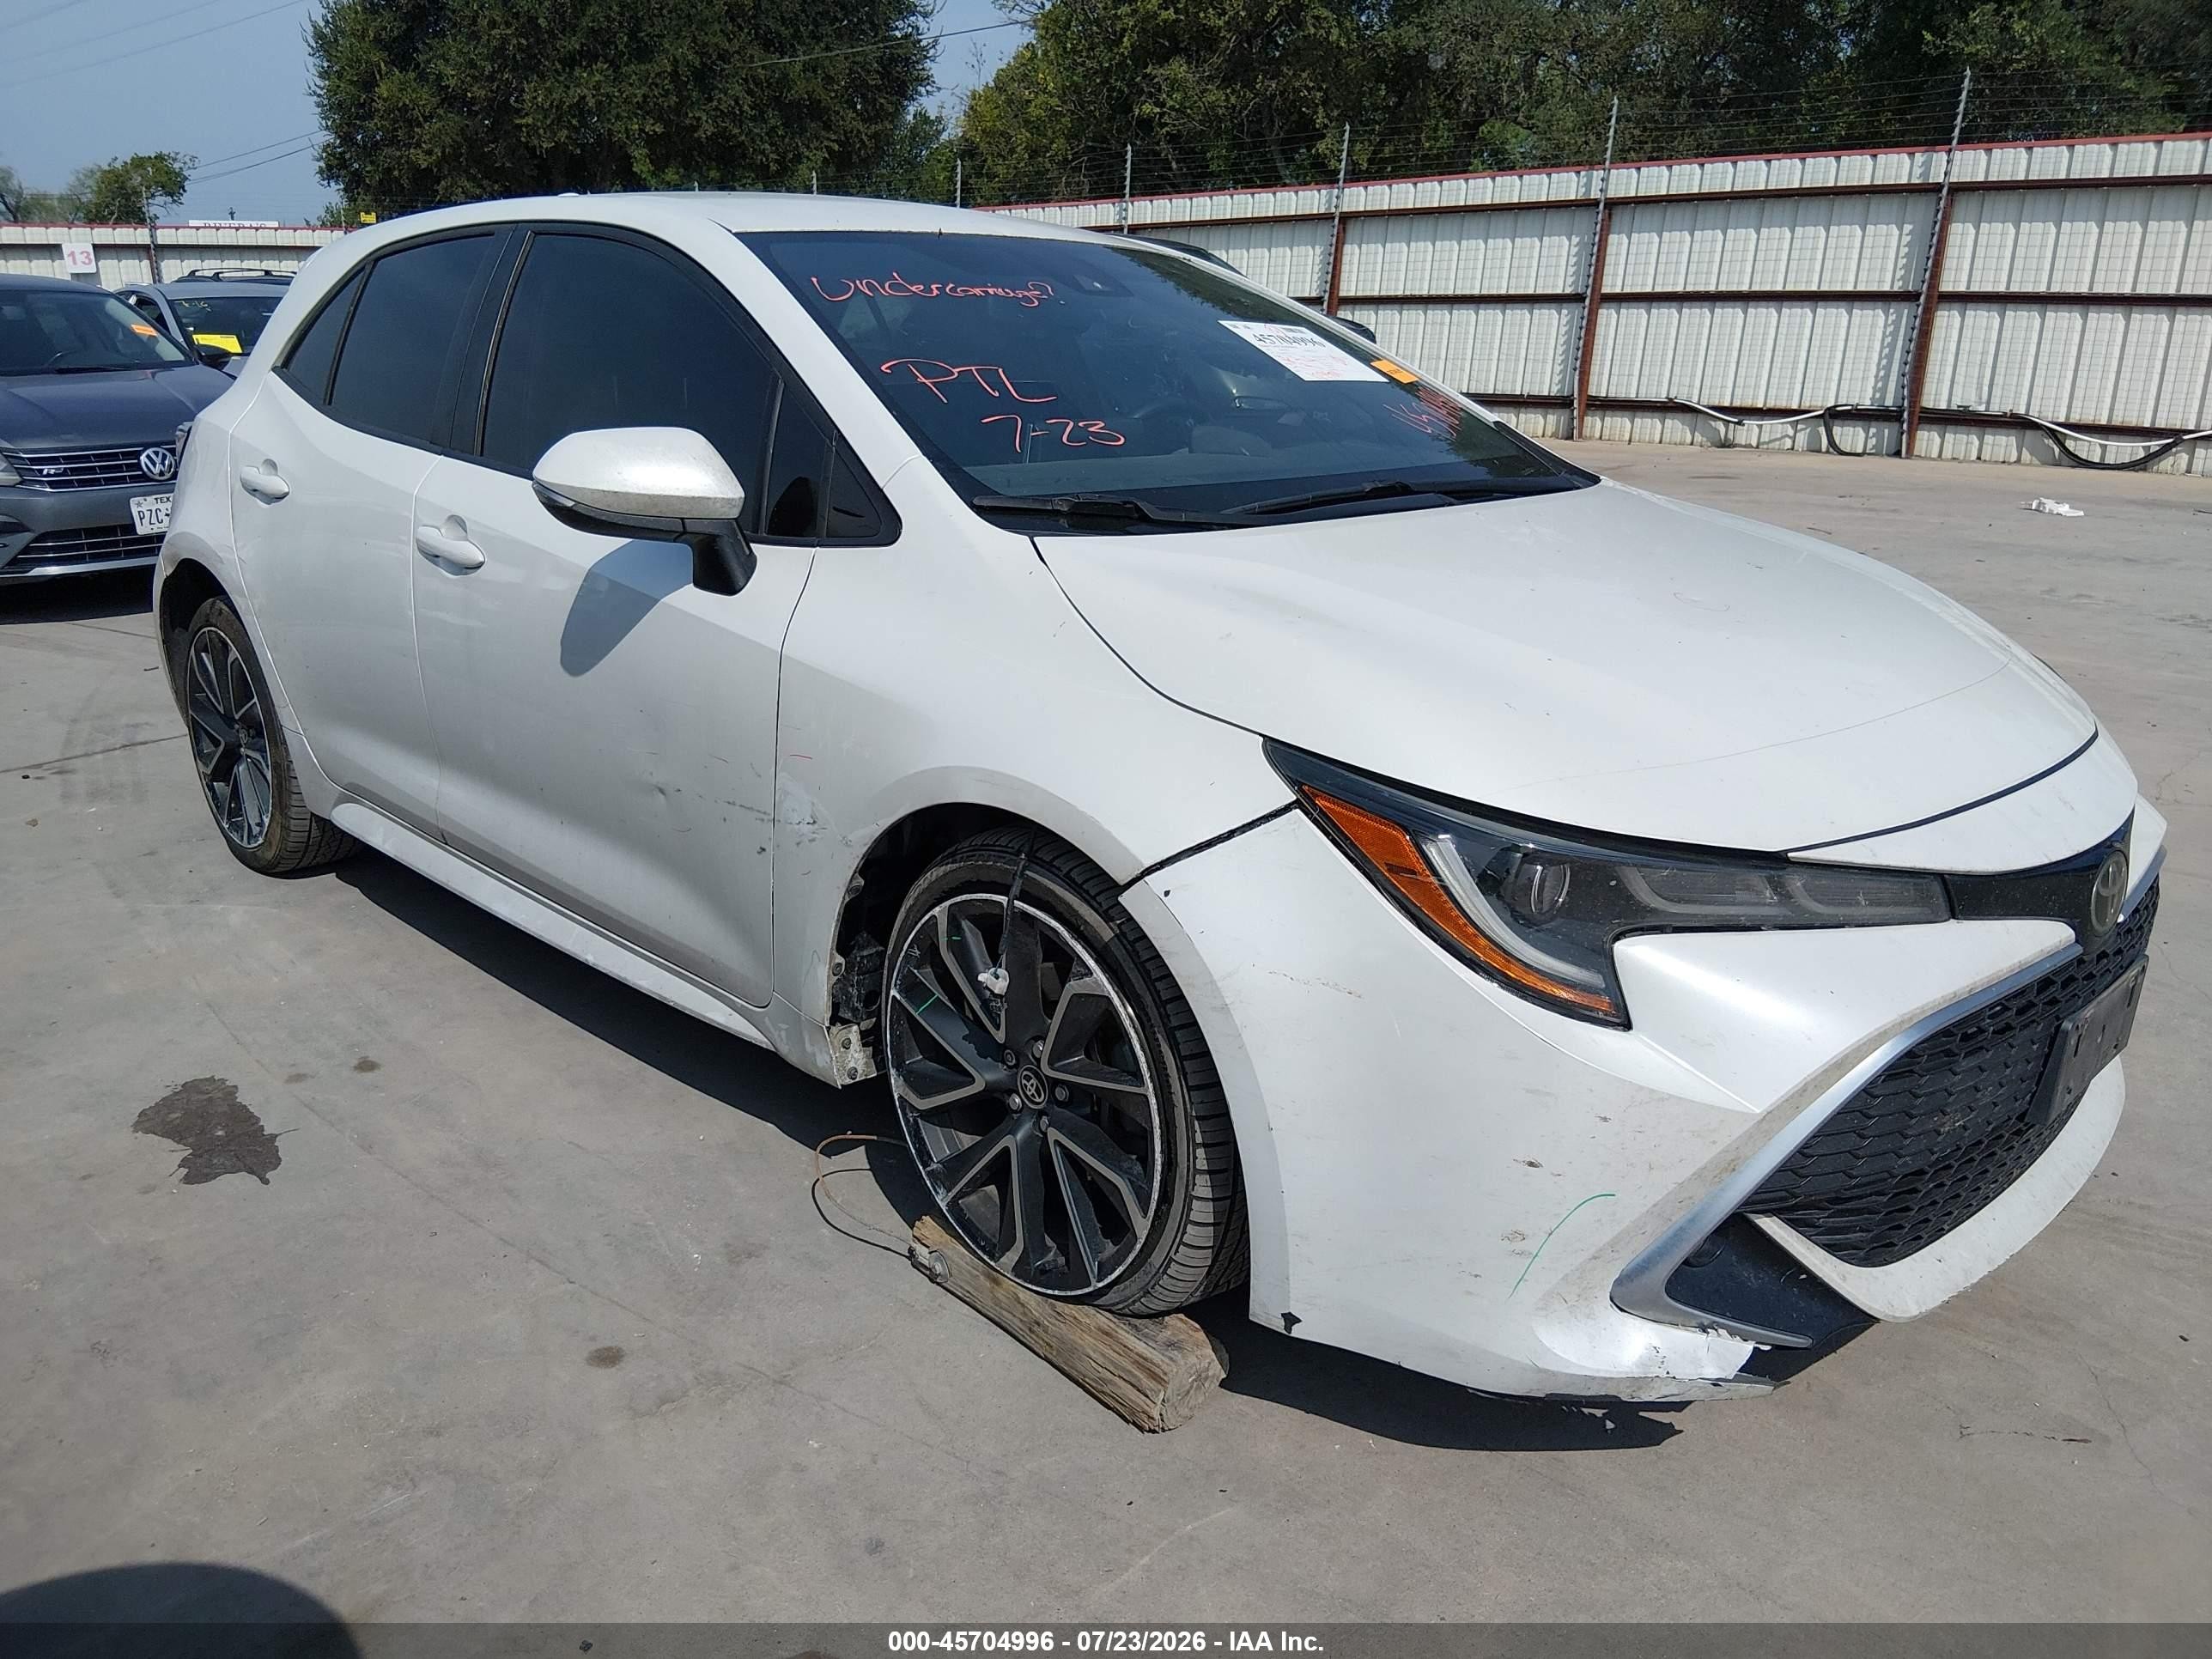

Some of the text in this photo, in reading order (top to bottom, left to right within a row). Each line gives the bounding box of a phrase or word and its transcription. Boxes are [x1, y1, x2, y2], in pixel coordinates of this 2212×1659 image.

[68, 250, 93, 265] 13
[880, 358, 1058, 404] PTL
[981, 415, 1127, 453] 7-23
